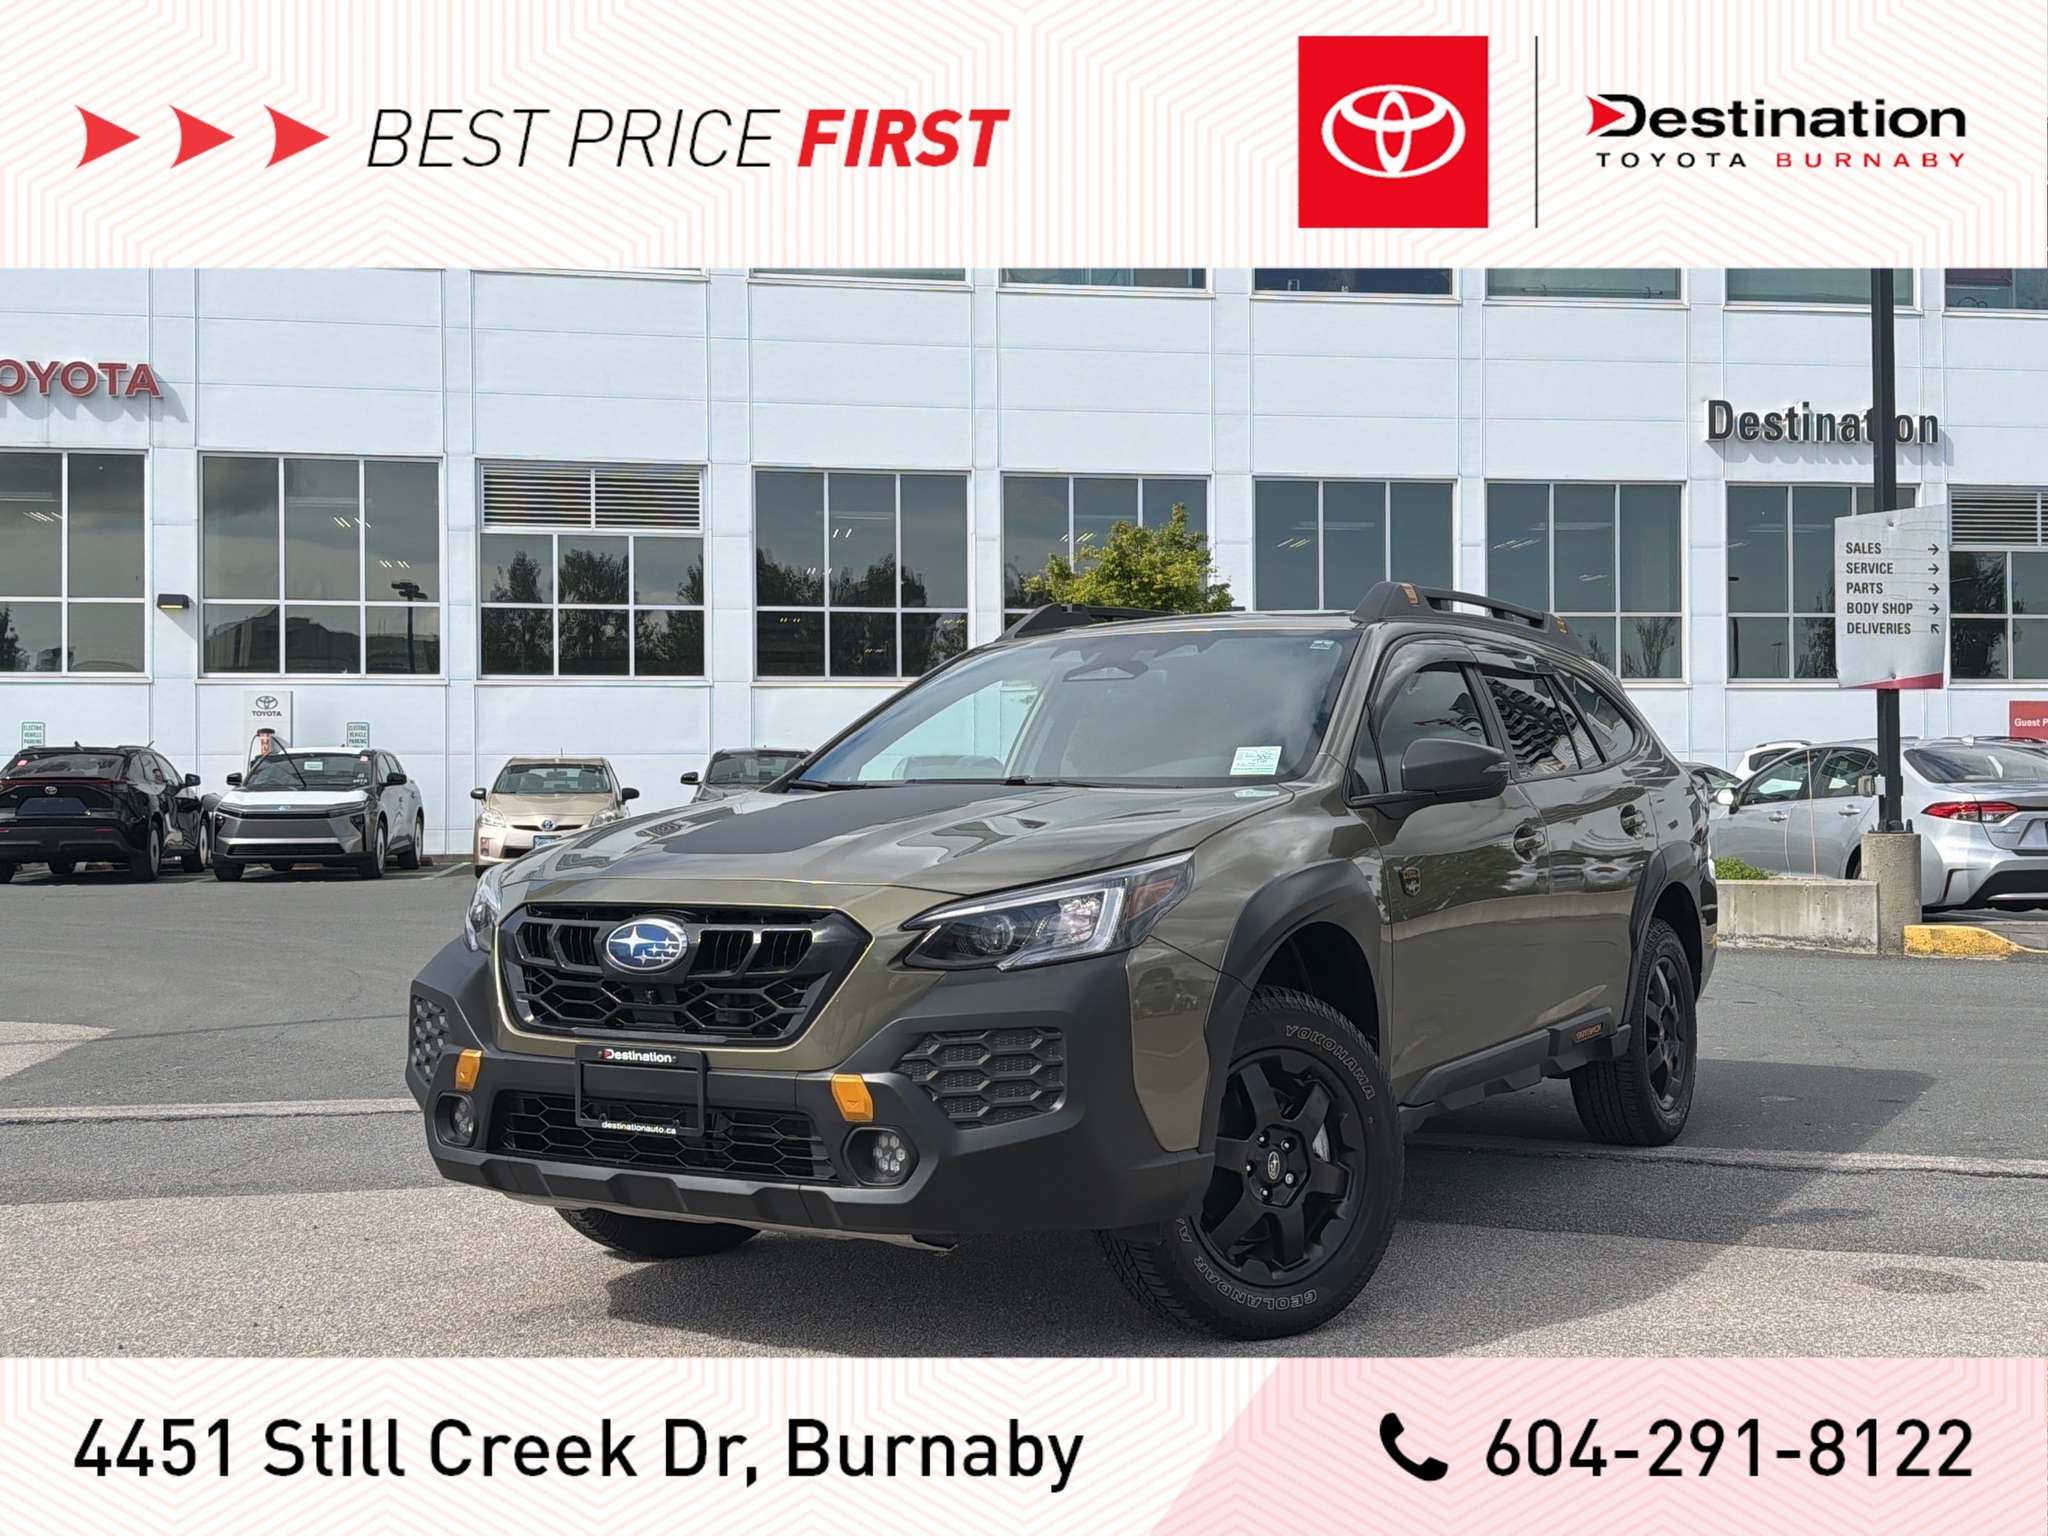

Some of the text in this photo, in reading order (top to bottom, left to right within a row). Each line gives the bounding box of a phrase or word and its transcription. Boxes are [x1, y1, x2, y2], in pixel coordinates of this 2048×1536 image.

[1705, 399, 1939, 443] Destinaton
[1846, 542, 1882, 554] SALES
[1846, 562, 1893, 574] SERVICE
[1846, 582, 1883, 594] PARTS
[1847, 602, 1913, 614] BODY SHOP
[1847, 622, 1911, 634] DELIVERIES
[2014, 717, 2041, 727] Guest
[604, 1048, 673, 1063] Destination
[1285, 1024, 1376, 1100] YOKOHAMA
[601, 1120, 677, 1135] destinationauto.ca
[1193, 1255, 1317, 1310] GEOLANDAR
